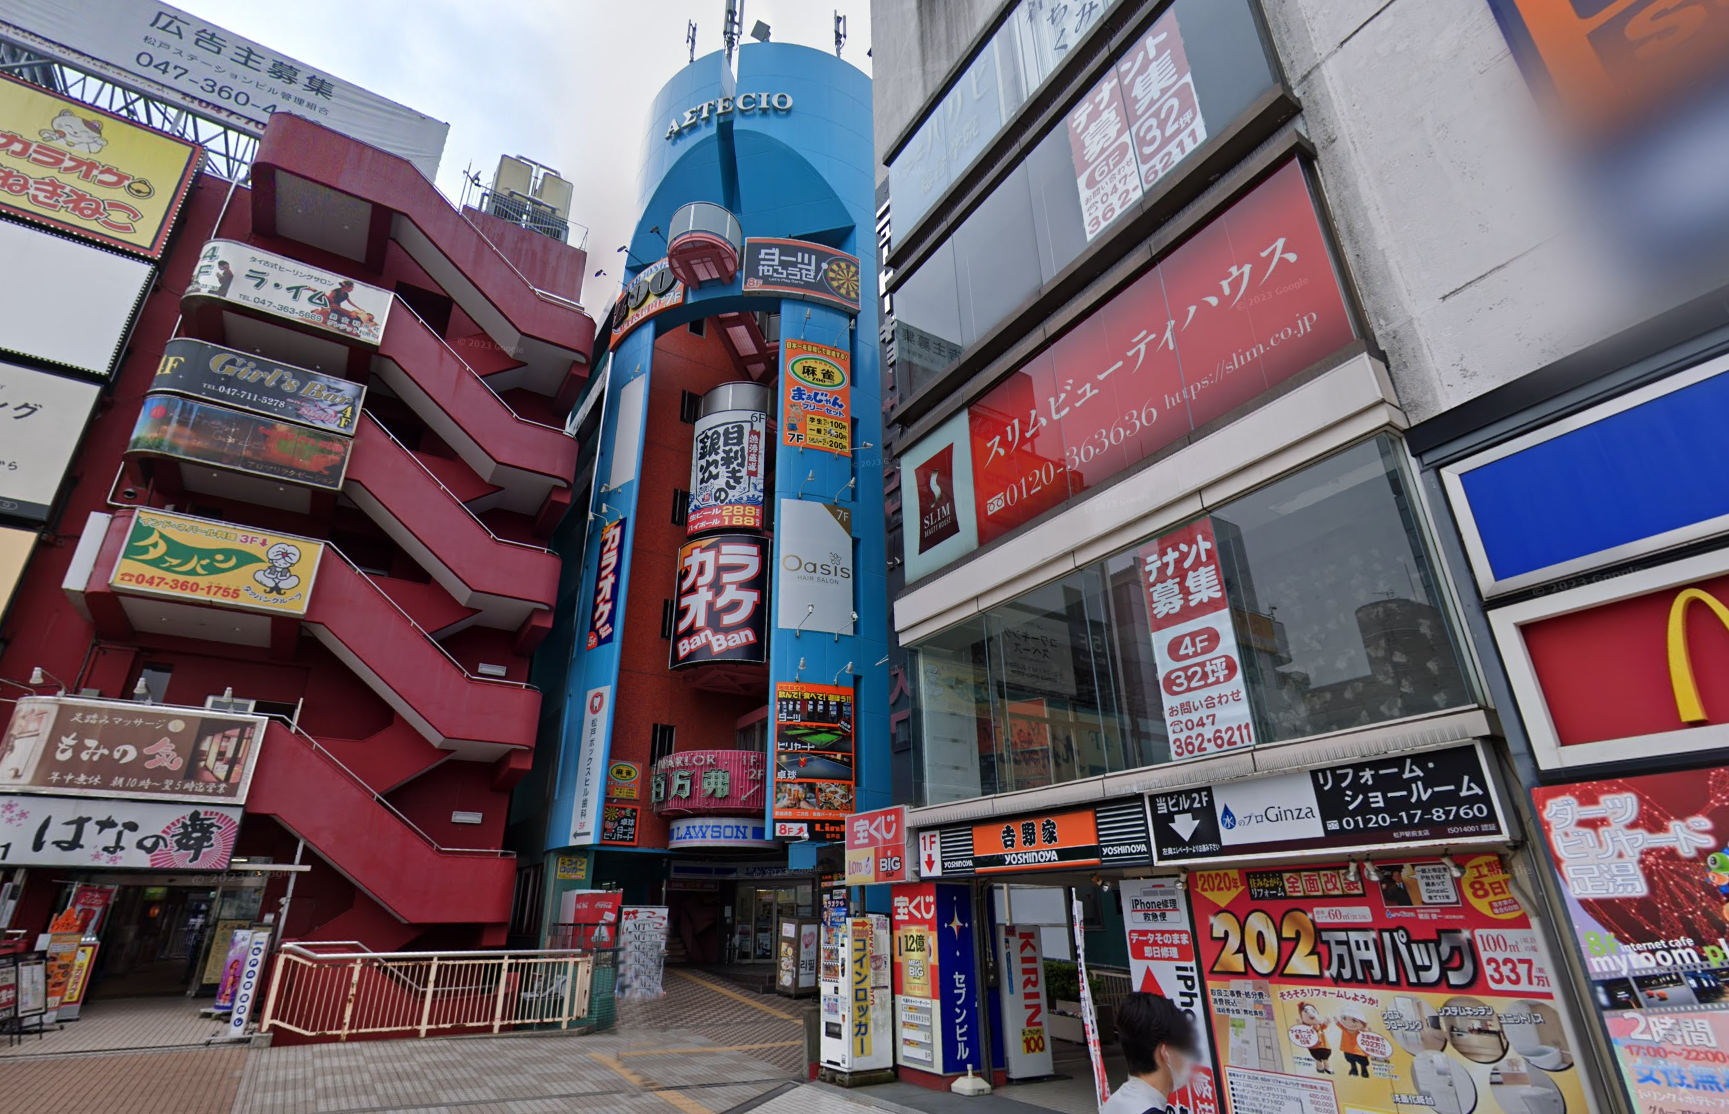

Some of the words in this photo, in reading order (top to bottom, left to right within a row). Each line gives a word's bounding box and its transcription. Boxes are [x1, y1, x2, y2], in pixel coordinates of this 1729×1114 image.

[150, 10, 334, 101] 広告主募集
[135, 51, 322, 126] 047-360-4
[142, 34, 329, 116] 松戸ステーションビル管理組合
[1072, 31, 1168, 135] テナント
[1081, 49, 1178, 164] 募集
[1139, 107, 1193, 156] 32坪
[0, 131, 132, 190] カラオケ
[1094, 151, 1120, 184] 6F
[1084, 157, 1135, 206] お問い合わせ
[1087, 128, 1198, 236] 362-6211
[250, 255, 335, 287] タイ古式ヒーリングサロン
[758, 247, 816, 271] ダーツ
[747, 277, 763, 288] 8F
[758, 265, 816, 283] やろうぜ
[244, 268, 331, 310] ラ・イム
[983, 236, 1299, 469] スリムビューティハウス
[208, 353, 301, 394] Girl's
[300, 380, 354, 405] Bar
[802, 365, 836, 382] 麻雀
[338, 404, 354, 429] 4F
[750, 412, 767, 423] 6F
[801, 403, 824, 412] フリー
[825, 407, 845, 418] セット
[1006, 397, 1158, 509] 0120-363636
[1163, 308, 1319, 410] https://slim.co.jp
[787, 432, 805, 444] 7F
[714, 424, 746, 504] 目利きの
[687, 518, 721, 533] ハイボール
[723, 516, 755, 526] 188
[689, 508, 722, 523] 生ビール
[722, 505, 756, 517] 288
[836, 509, 849, 521] 7F
[923, 501, 951, 530] SLIM
[239, 534, 259, 546] 3F
[782, 554, 851, 579] Oasis
[1145, 534, 1213, 582] テナント
[135, 573, 241, 600] 047-360-1755
[593, 525, 622, 631] カラオケ
[816, 576, 839, 585] SALON
[1150, 564, 1222, 619] 募集
[1177, 633, 1210, 656] 4F
[1170, 659, 1230, 691] 32坪
[1168, 689, 1242, 717] お問い合わせ
[70, 712, 167, 729] 足踏みマッサージ
[1184, 713, 1217, 731] 047
[1172, 722, 1253, 758] 362-6211
[47, 771, 102, 786] 年中無休
[776, 770, 797, 780] 卓球
[1344, 775, 1484, 811] ショールーム
[1341, 803, 1489, 831] 0120-17-8760
[1545, 791, 1640, 832] ダーツ
[31, 809, 224, 863] はなの舞
[675, 825, 749, 841] LAWSON
[778, 824, 794, 836] 8F
[853, 814, 897, 845] 宝くじ
[921, 833, 937, 852] 1F
[1554, 818, 1718, 860] ビリヤード
[879, 856, 902, 873] BIG
[1199, 872, 1241, 893] 2020年
[1564, 862, 1649, 898] 足湯
[893, 894, 935, 921] 宝くじ
[1131, 898, 1178, 910] iPhone修理
[1142, 912, 1168, 923] 救急便
[1131, 933, 1190, 945] データそのまま
[1210, 908, 1479, 990] 202万円パック
[1583, 931, 1620, 957] 8F
[1620, 939, 1668, 953] internet
[1668, 935, 1695, 949] cafe
[1143, 946, 1180, 960] 即日修理
[1589, 946, 1701, 977] myroom
[908, 966, 925, 978] BIG
[1018, 931, 1043, 1028] KIRIN
[853, 938, 871, 1056] コインロッカー
[1279, 988, 1379, 1008] そろそろリフォームしようか!
[953, 971, 970, 1061] セブンビル
[1437, 1006, 1496, 1017] システムキッチン
[1384, 1020, 1424, 1032] フローリング
[1622, 1011, 1719, 1048] 2時間
[1023, 1035, 1046, 1055] 100
[1630, 1056, 1729, 1093] 女性無
